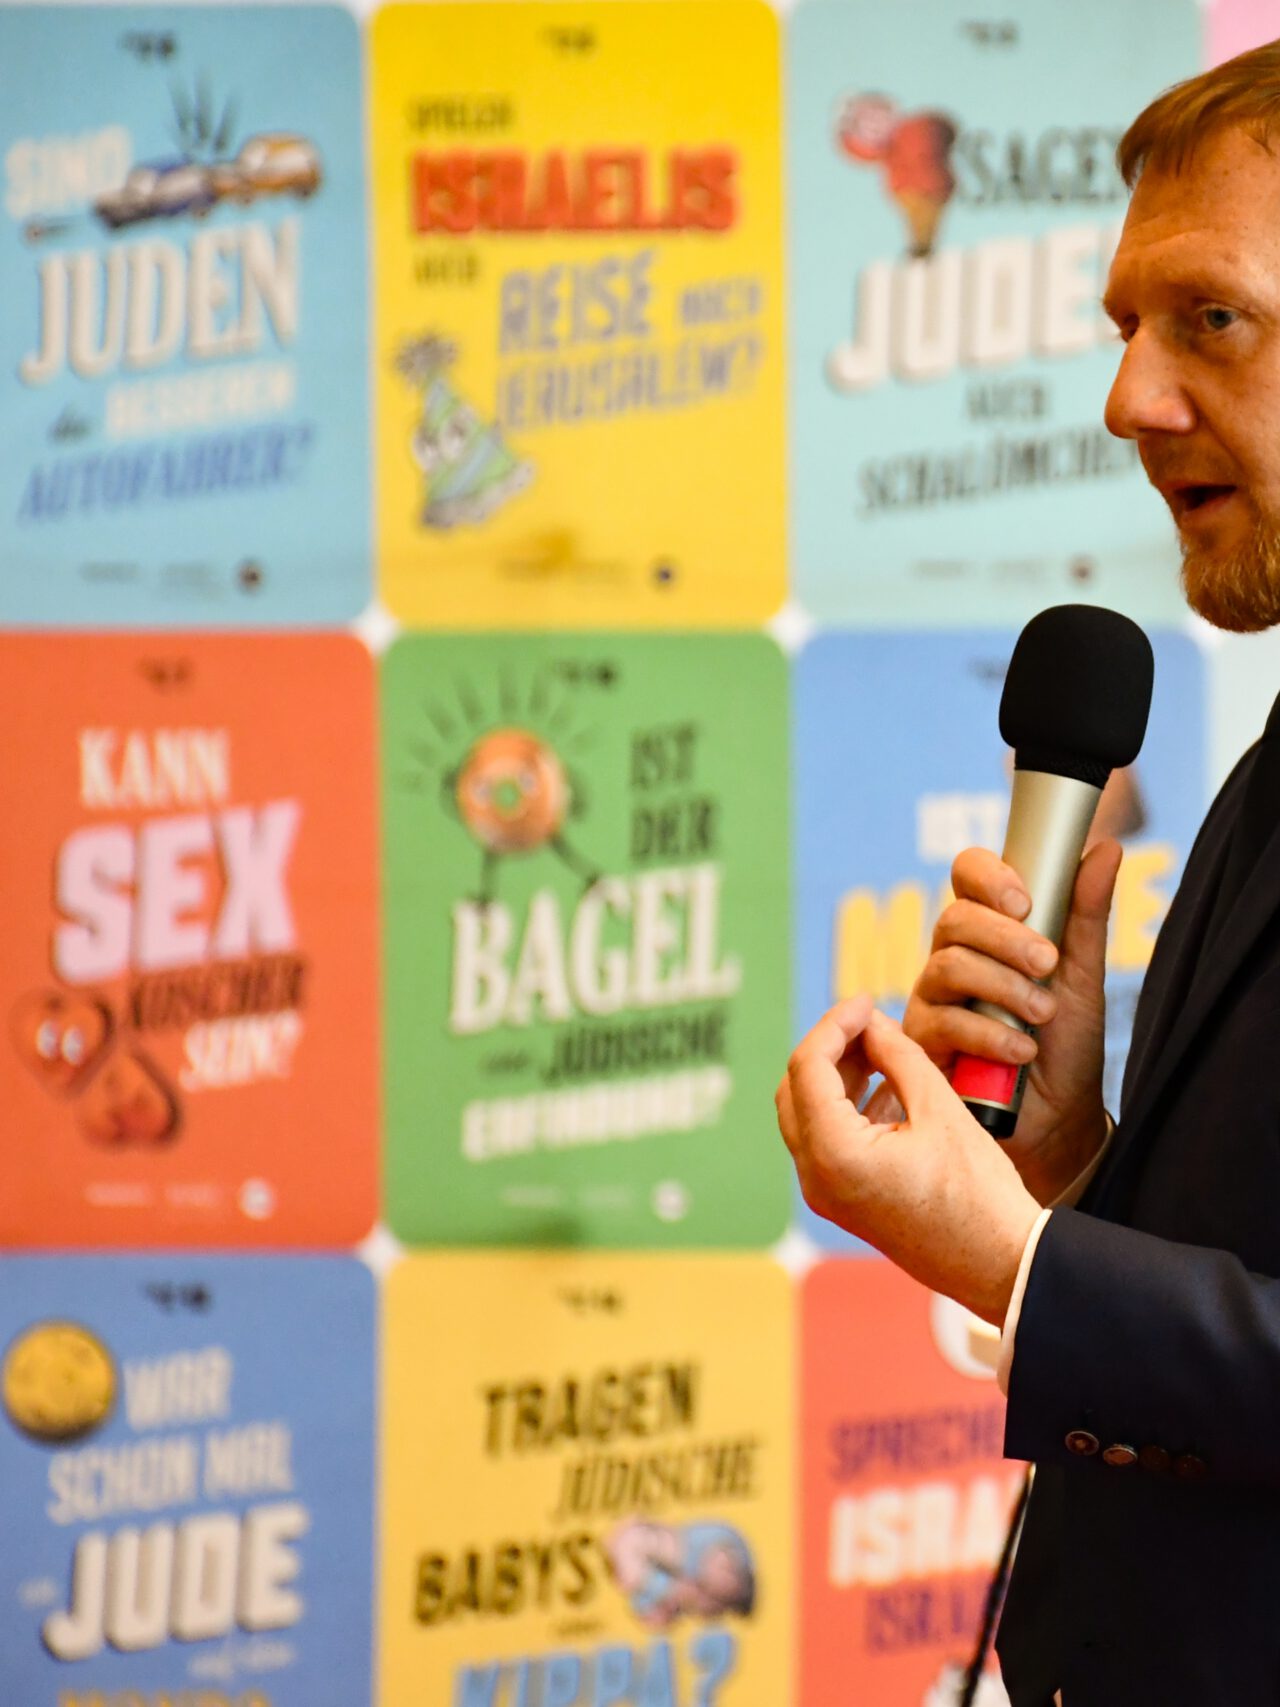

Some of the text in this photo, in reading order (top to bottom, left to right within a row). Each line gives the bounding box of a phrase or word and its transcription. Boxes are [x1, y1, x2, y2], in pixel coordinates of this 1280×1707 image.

[410, 147, 738, 237] ISRAELIS
[18, 215, 301, 387] JUDEN
[500, 250, 658, 353] REISE
[78, 726, 230, 810] KANN
[630, 721, 697, 792] IST
[630, 796, 721, 862] DER
[52, 797, 303, 985] SEX
[449, 862, 743, 1035] BAGEL
[481, 1359, 699, 1458] TRAGEN
[42, 1502, 310, 1662] JUDE
[414, 1532, 595, 1628] BABYS
[829, 1474, 1010, 1589] ISRA
